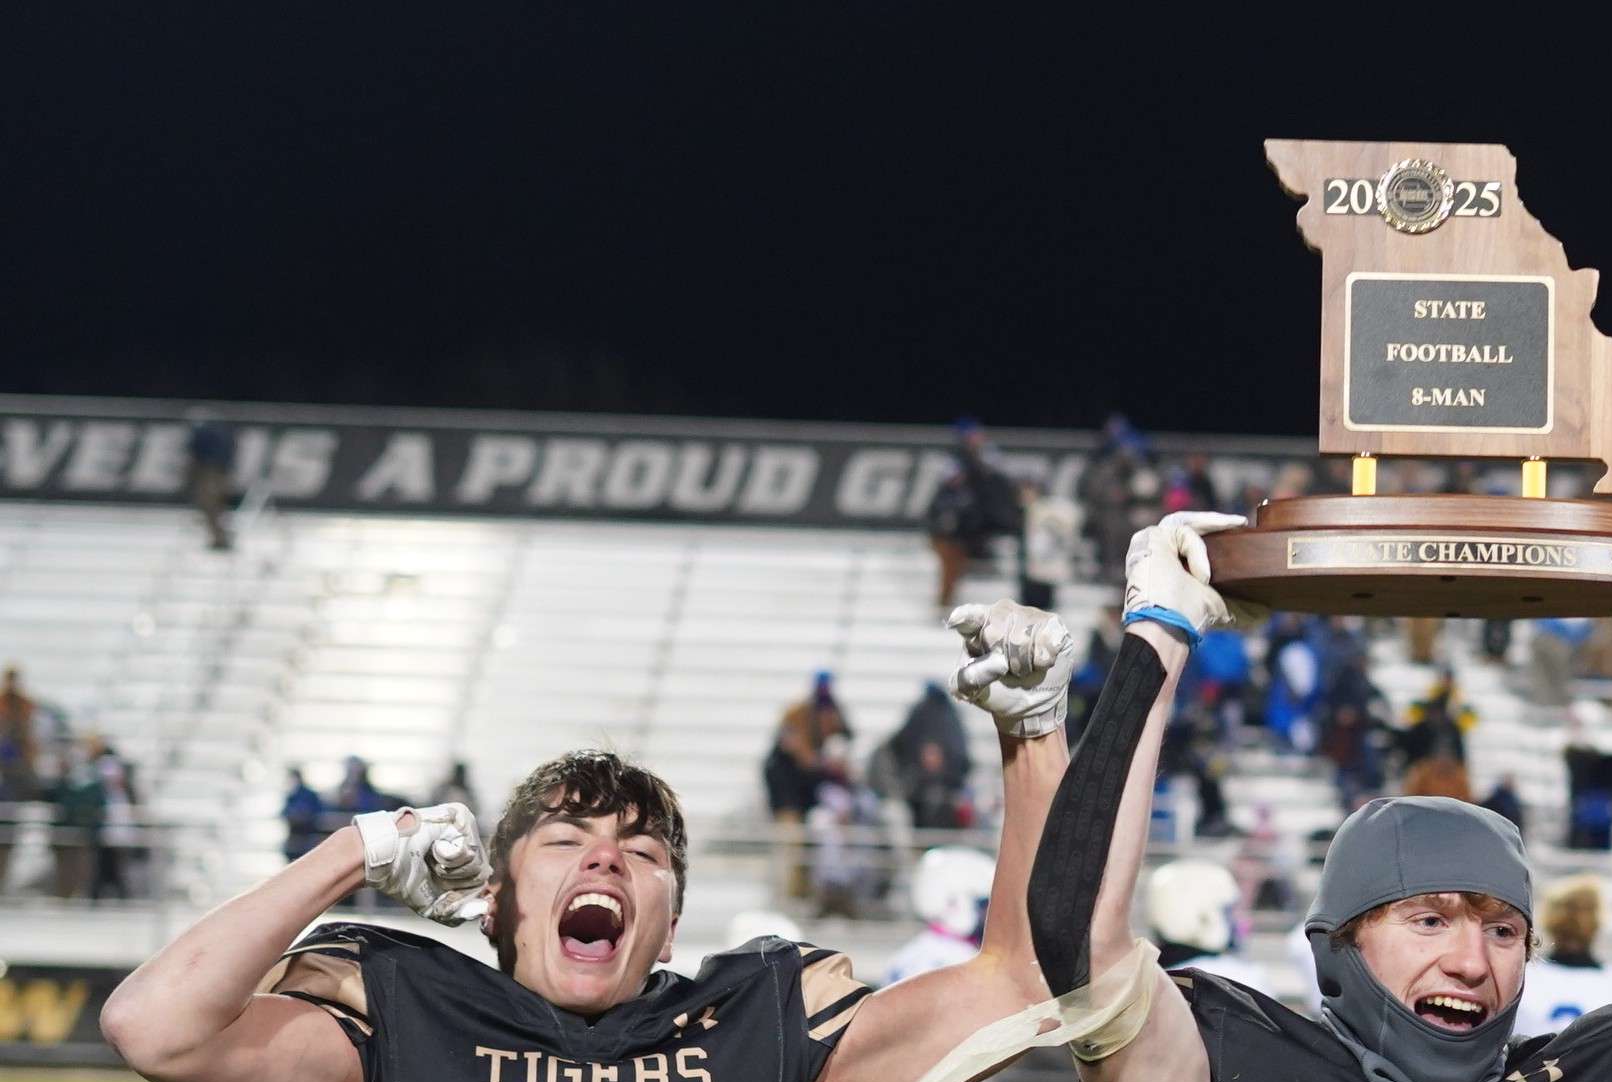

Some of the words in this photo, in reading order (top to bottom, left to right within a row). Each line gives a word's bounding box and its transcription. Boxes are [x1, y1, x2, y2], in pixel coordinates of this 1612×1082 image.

[1327, 179, 1374, 214] 20
[1455, 182, 1502, 217] 25
[1413, 300, 1486, 320] STATE
[1386, 343, 1513, 364] FOOTBALL
[1411, 388, 1486, 407] 8-MAN
[232, 426, 340, 499] IS
[355, 431, 436, 502] A
[456, 431, 820, 515] PROUD
[1418, 541, 1577, 566] CHAMPIONS
